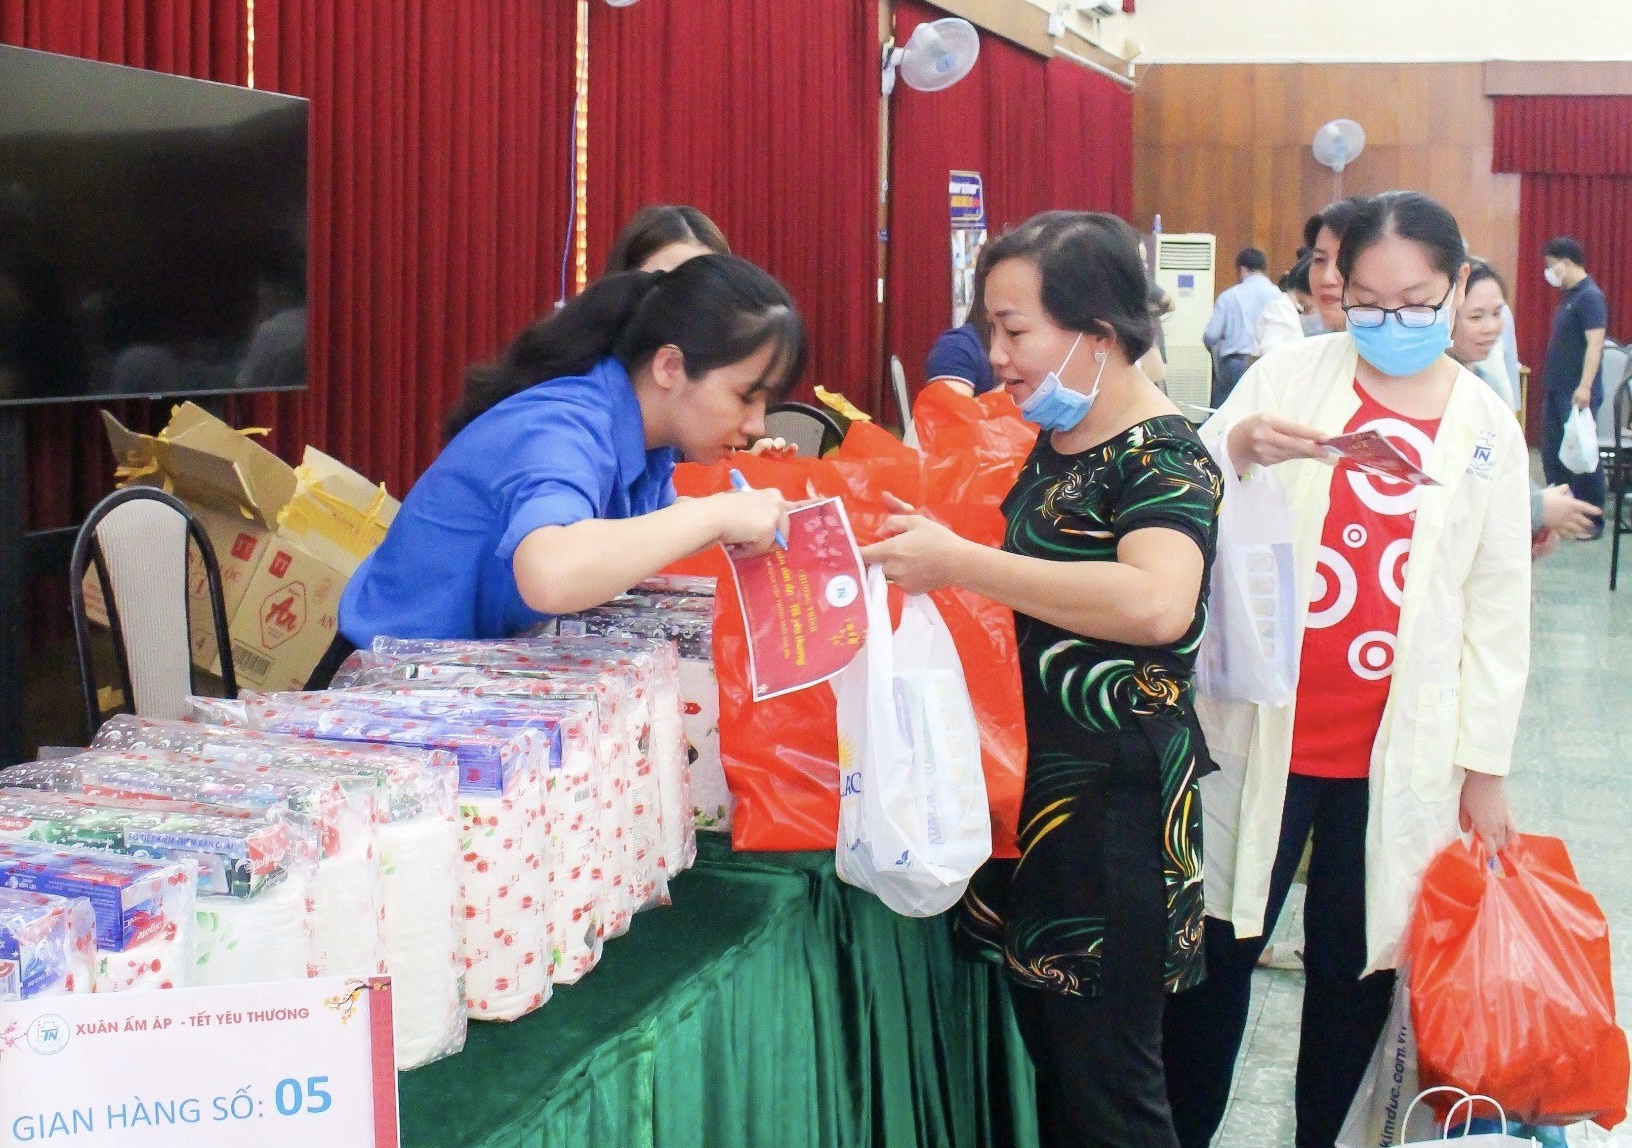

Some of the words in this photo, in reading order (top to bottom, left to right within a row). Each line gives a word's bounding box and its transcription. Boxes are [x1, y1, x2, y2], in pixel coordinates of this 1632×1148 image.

[841, 772, 862, 797] AC
[75, 1018, 119, 1036] XUÂN
[123, 1012, 147, 1032] ẤM
[150, 1014, 173, 1030] ÁP
[189, 1009, 212, 1028] TẾT
[216, 1009, 243, 1026] YÊU
[247, 1007, 310, 1023] THƯƠNG
[12, 1105, 94, 1142] GIAN
[107, 1095, 201, 1130] HÀNG
[212, 1084, 265, 1122] SỐ:
[275, 1075, 332, 1116] 05
